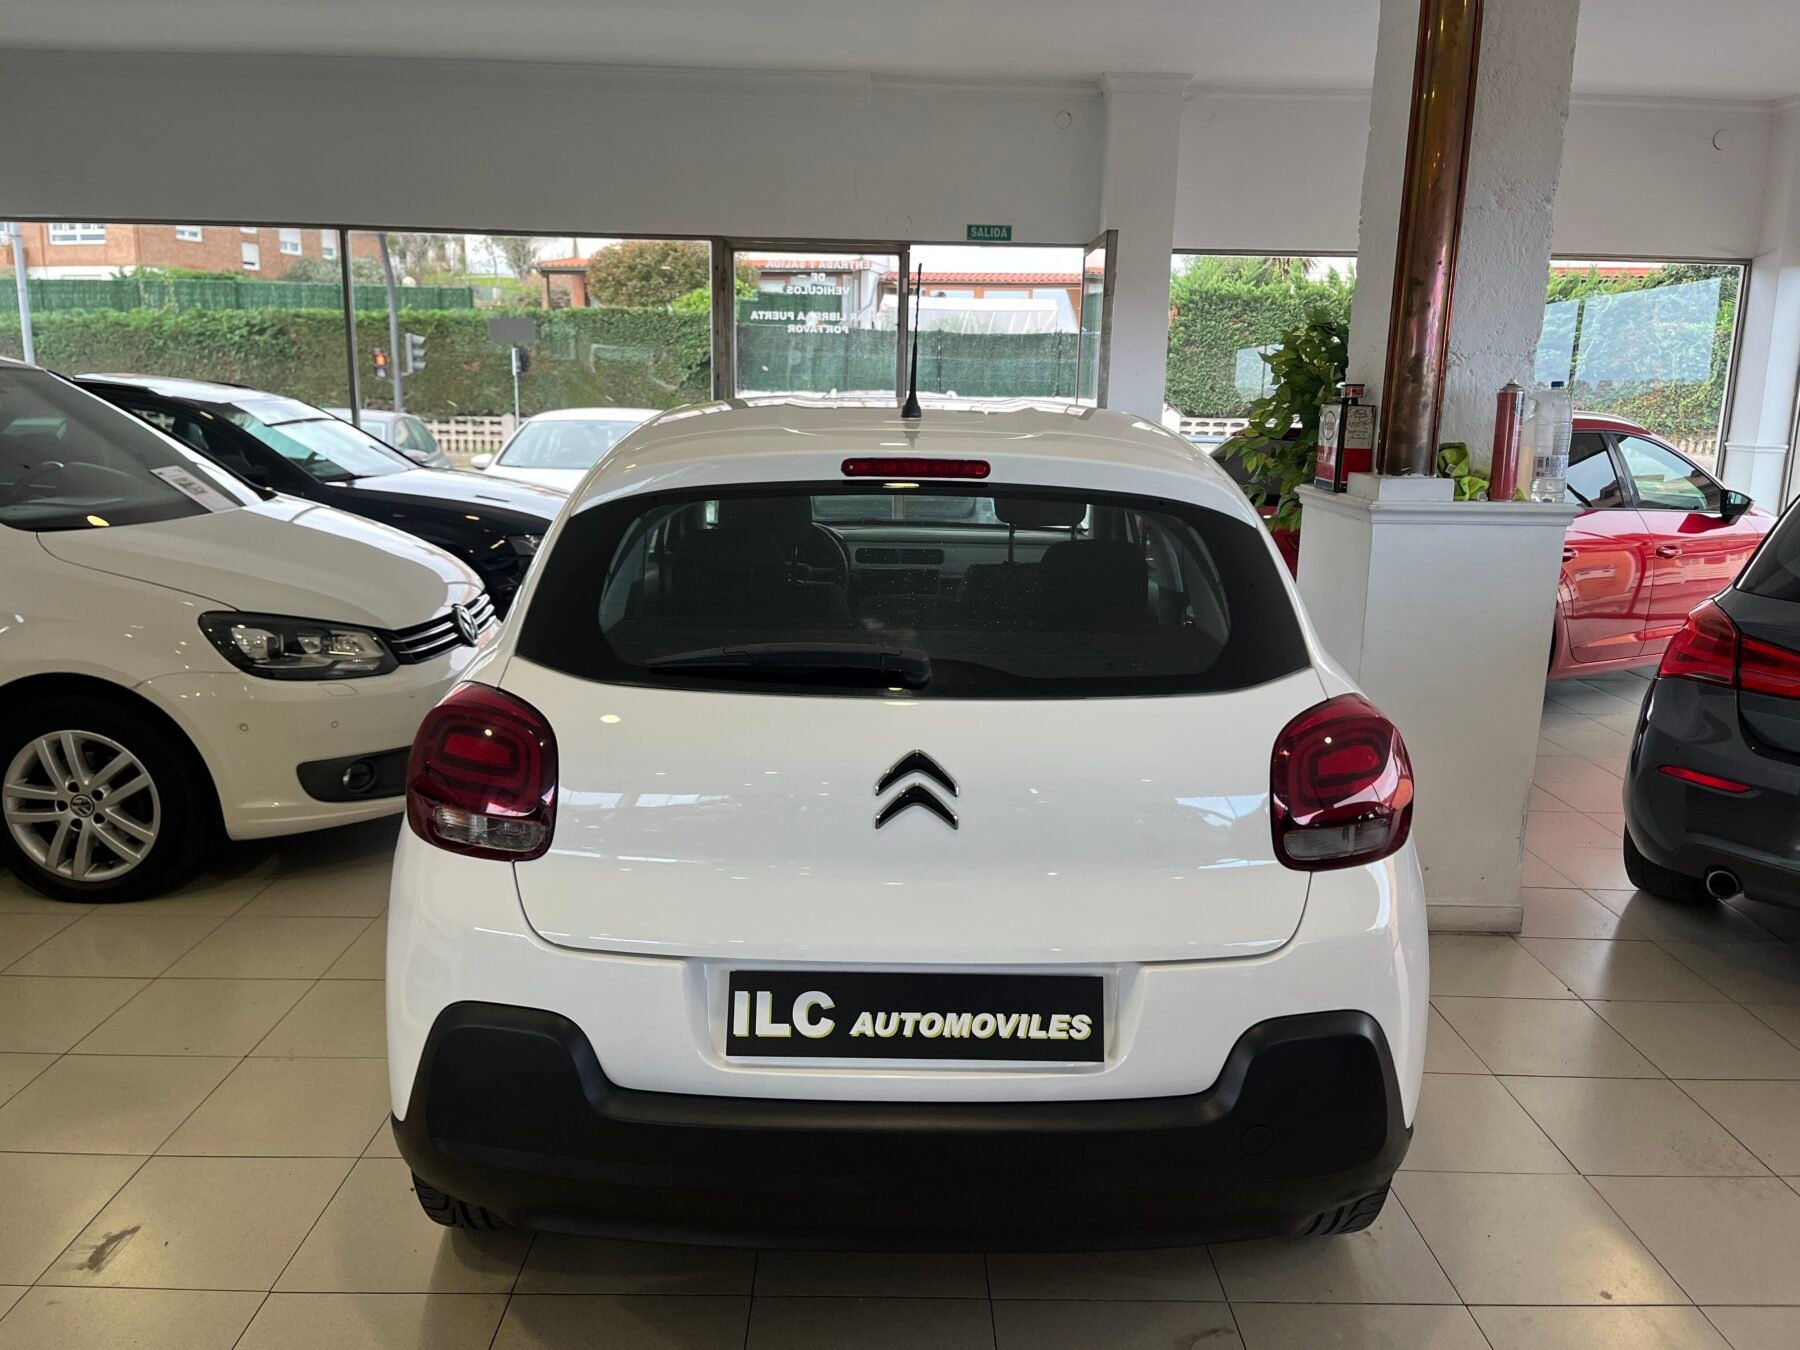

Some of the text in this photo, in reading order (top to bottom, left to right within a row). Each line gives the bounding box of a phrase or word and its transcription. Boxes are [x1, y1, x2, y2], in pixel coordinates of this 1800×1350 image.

[970, 226, 1008, 238] SALIDA
[732, 990, 1093, 1041] ILC AUTOMOVILES
